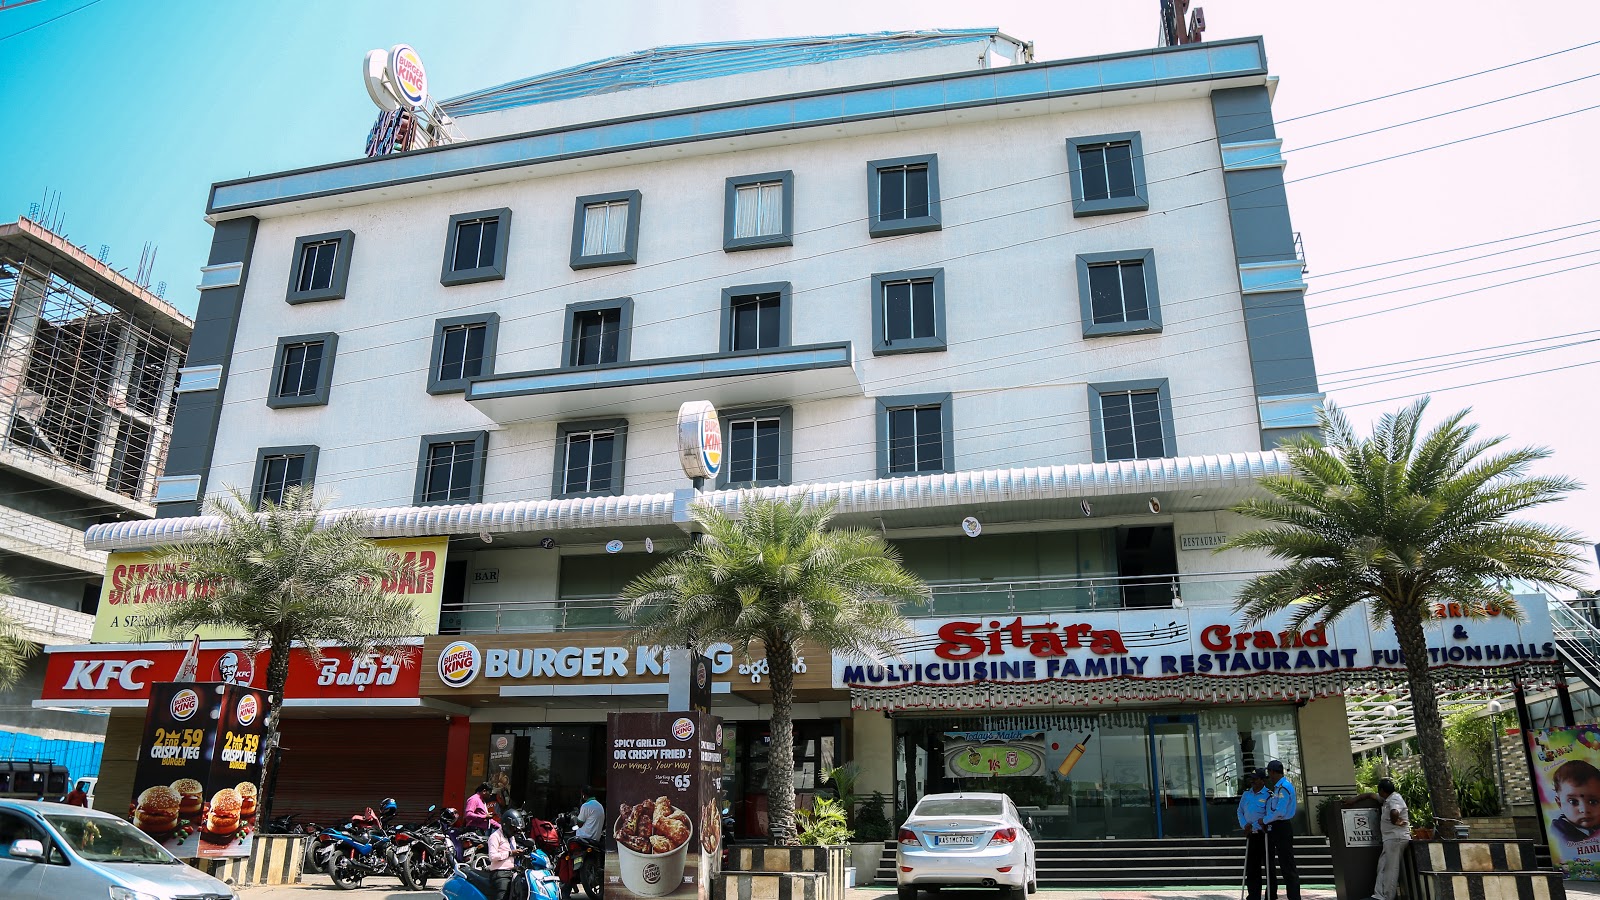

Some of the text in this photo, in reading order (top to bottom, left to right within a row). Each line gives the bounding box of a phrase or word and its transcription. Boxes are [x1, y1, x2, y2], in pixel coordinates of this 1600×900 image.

[399, 56, 423, 79] BURGER
[397, 66, 423, 91] KING
[1183, 536, 1226, 547] RESTAURANT
[475, 571, 497, 581] BAR
[1453, 624, 1468, 639] &
[934, 617, 1329, 660] Sitara Grand
[444, 650, 473, 664] BURGER
[1487, 642, 1555, 661] HALLS
[444, 657, 473, 676] KING
[485, 646, 629, 678] BURGER
[843, 649, 1357, 684] MULTICUISINE FAMILY RESTAURANT
[62, 659, 154, 691] KFC
[174, 695, 195, 705] BURGER
[240, 702, 255, 710] BURGER
[174, 701, 195, 712] KING
[239, 708, 255, 717] KING
[675, 727, 691, 735] KING
[965, 731, 1023, 741] Today's Match
[154, 728, 165, 746] 2
[165, 738, 179, 747] FOR
[225, 731, 233, 749] 2
[614, 738, 667, 747] SPICY GRILLED
[151, 746, 200, 759] CRISPY VEG
[221, 750, 256, 763] CRISPY VEG
[614, 750, 626, 760] OR
[627, 749, 658, 760] CRISPY
[660, 749, 686, 759] FRIED
[162, 757, 186, 766] BURGER
[229, 761, 247, 770] BURGER
[612, 761, 627, 769] Our
[656, 760, 673, 771] Your
[645, 871, 661, 880] KING
